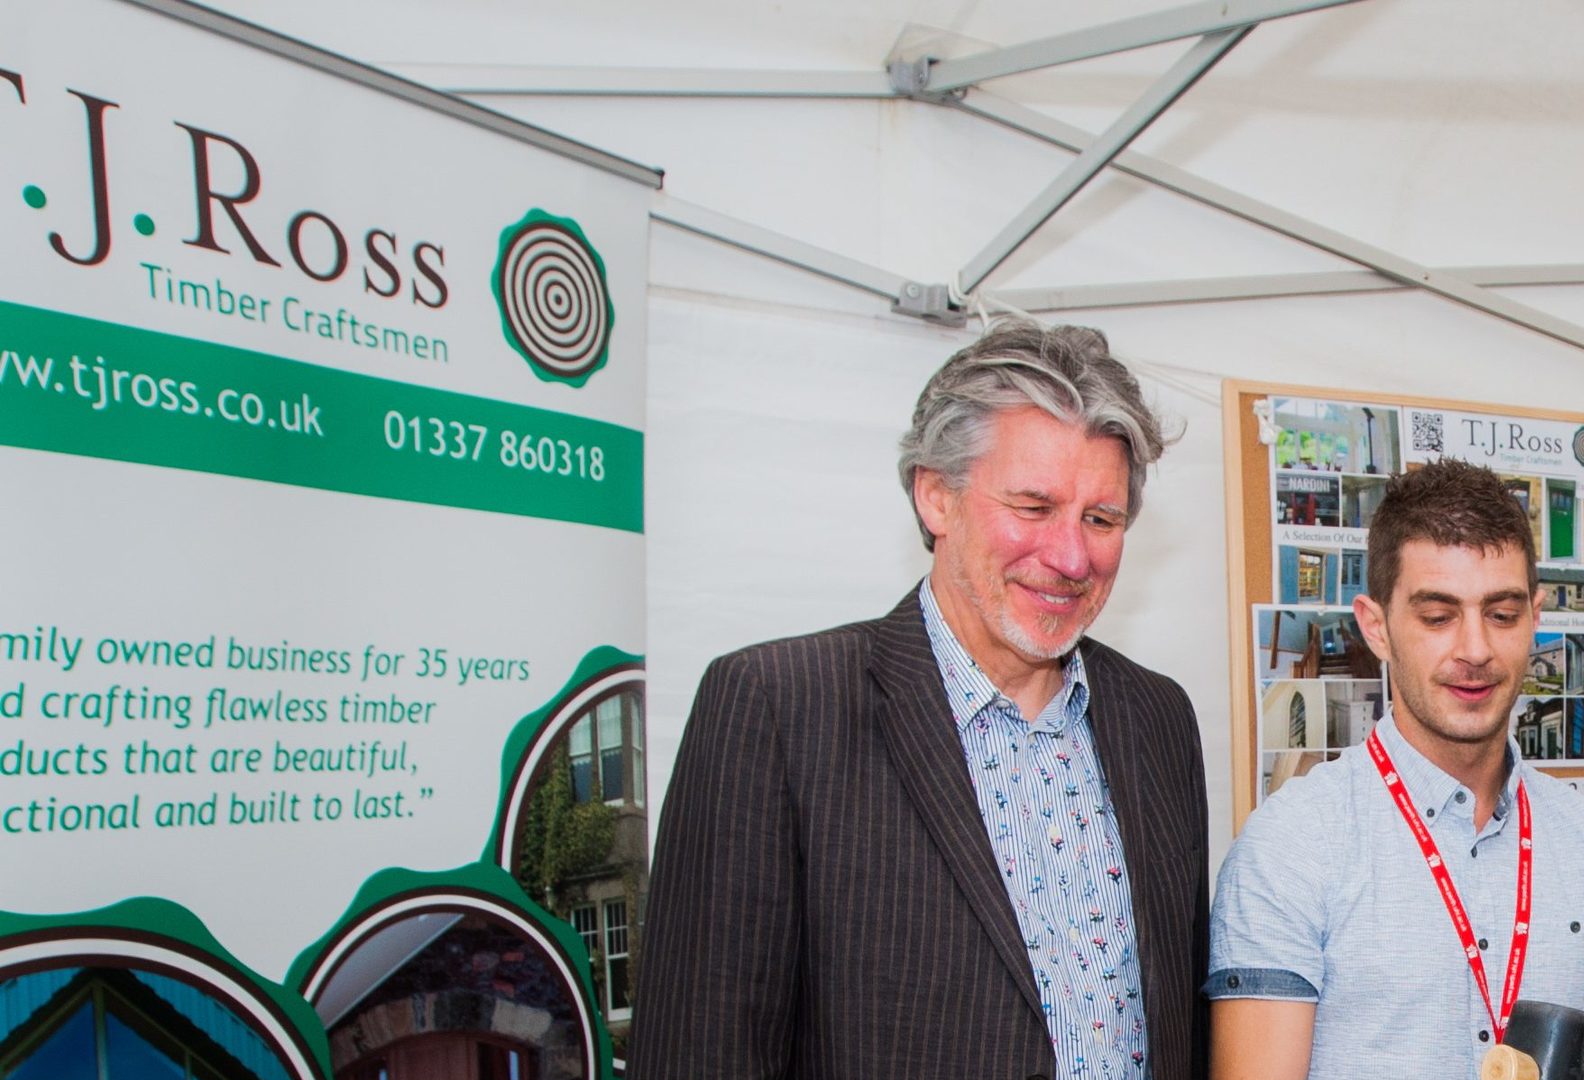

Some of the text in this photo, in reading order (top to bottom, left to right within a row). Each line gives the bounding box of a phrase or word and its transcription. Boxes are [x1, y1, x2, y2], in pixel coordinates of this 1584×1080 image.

[141, 262, 449, 363] Timber Craftsmen
[384, 410, 605, 483] 01337 860318
[1461, 418, 1563, 456] T.J.Ross
[1288, 477, 1331, 492] NARDINI
[1283, 530, 1290, 540] A
[1293, 531, 1331, 541] Selection
[1333, 533, 1345, 542] Of
[97, 635, 215, 669] owned
[227, 636, 351, 674] business
[361, 645, 405, 682] for
[416, 648, 447, 678] 35
[458, 656, 530, 686] years
[41, 685, 192, 729] crafting
[203, 687, 328, 729] flawless
[340, 693, 437, 724] timber
[0, 740, 418, 778] ducts that are beautiful,
[3, 794, 140, 833] ctional
[154, 792, 217, 827] and
[228, 789, 300, 825] built
[313, 793, 342, 821] to
